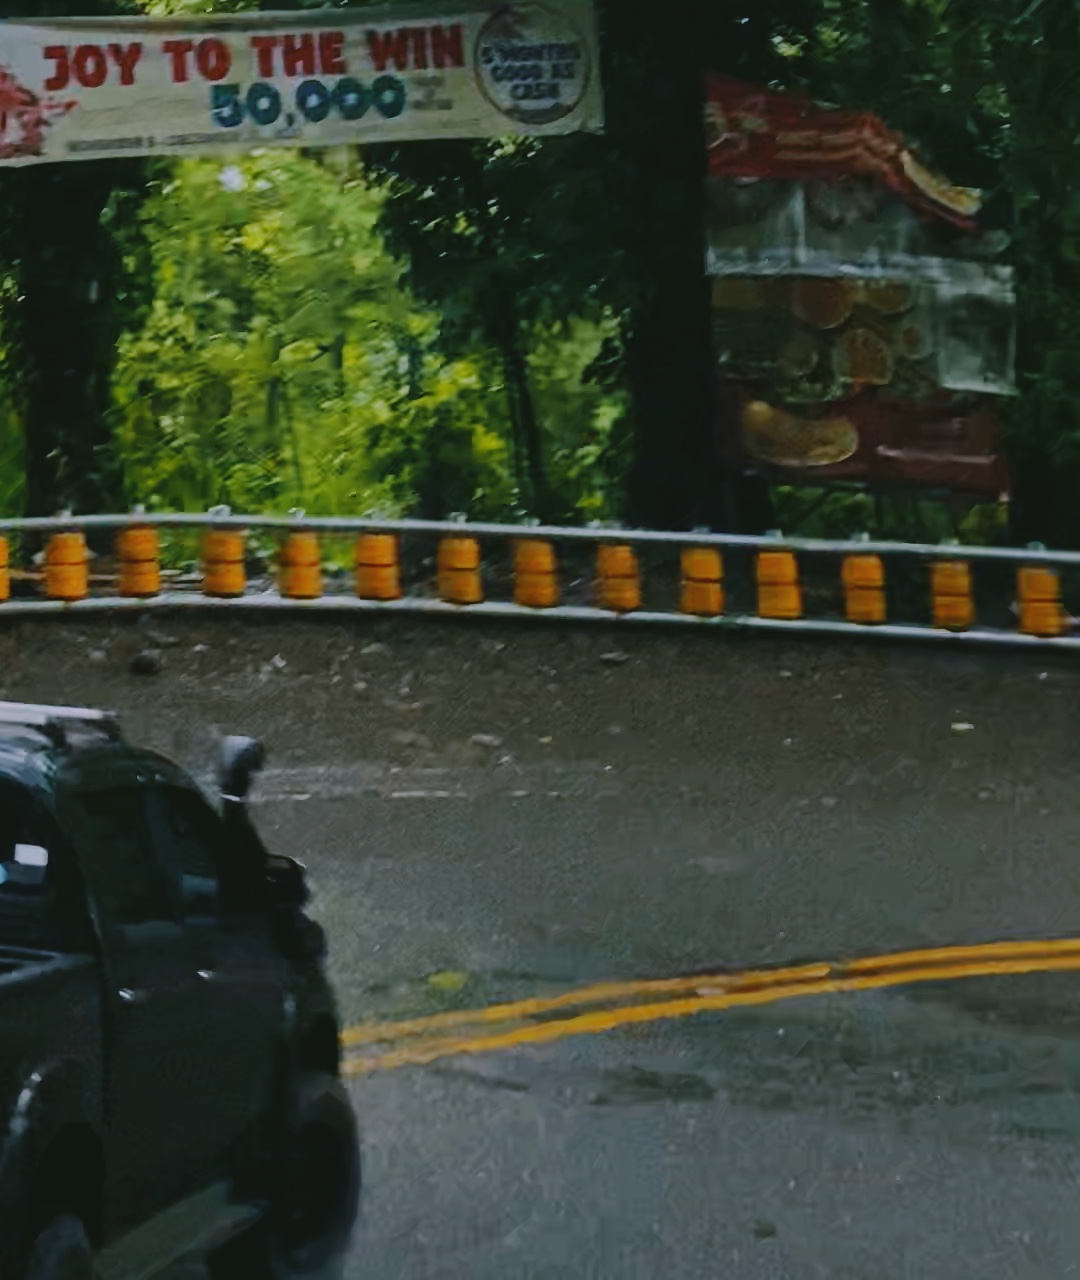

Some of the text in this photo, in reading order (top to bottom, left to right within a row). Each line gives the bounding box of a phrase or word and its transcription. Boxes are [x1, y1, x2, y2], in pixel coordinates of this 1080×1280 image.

[44, 42, 142, 92] JOY
[163, 39, 232, 84] TO
[250, 31, 348, 79] THE
[366, 23, 466, 73] WIN
[209, 74, 407, 130] 50,000
